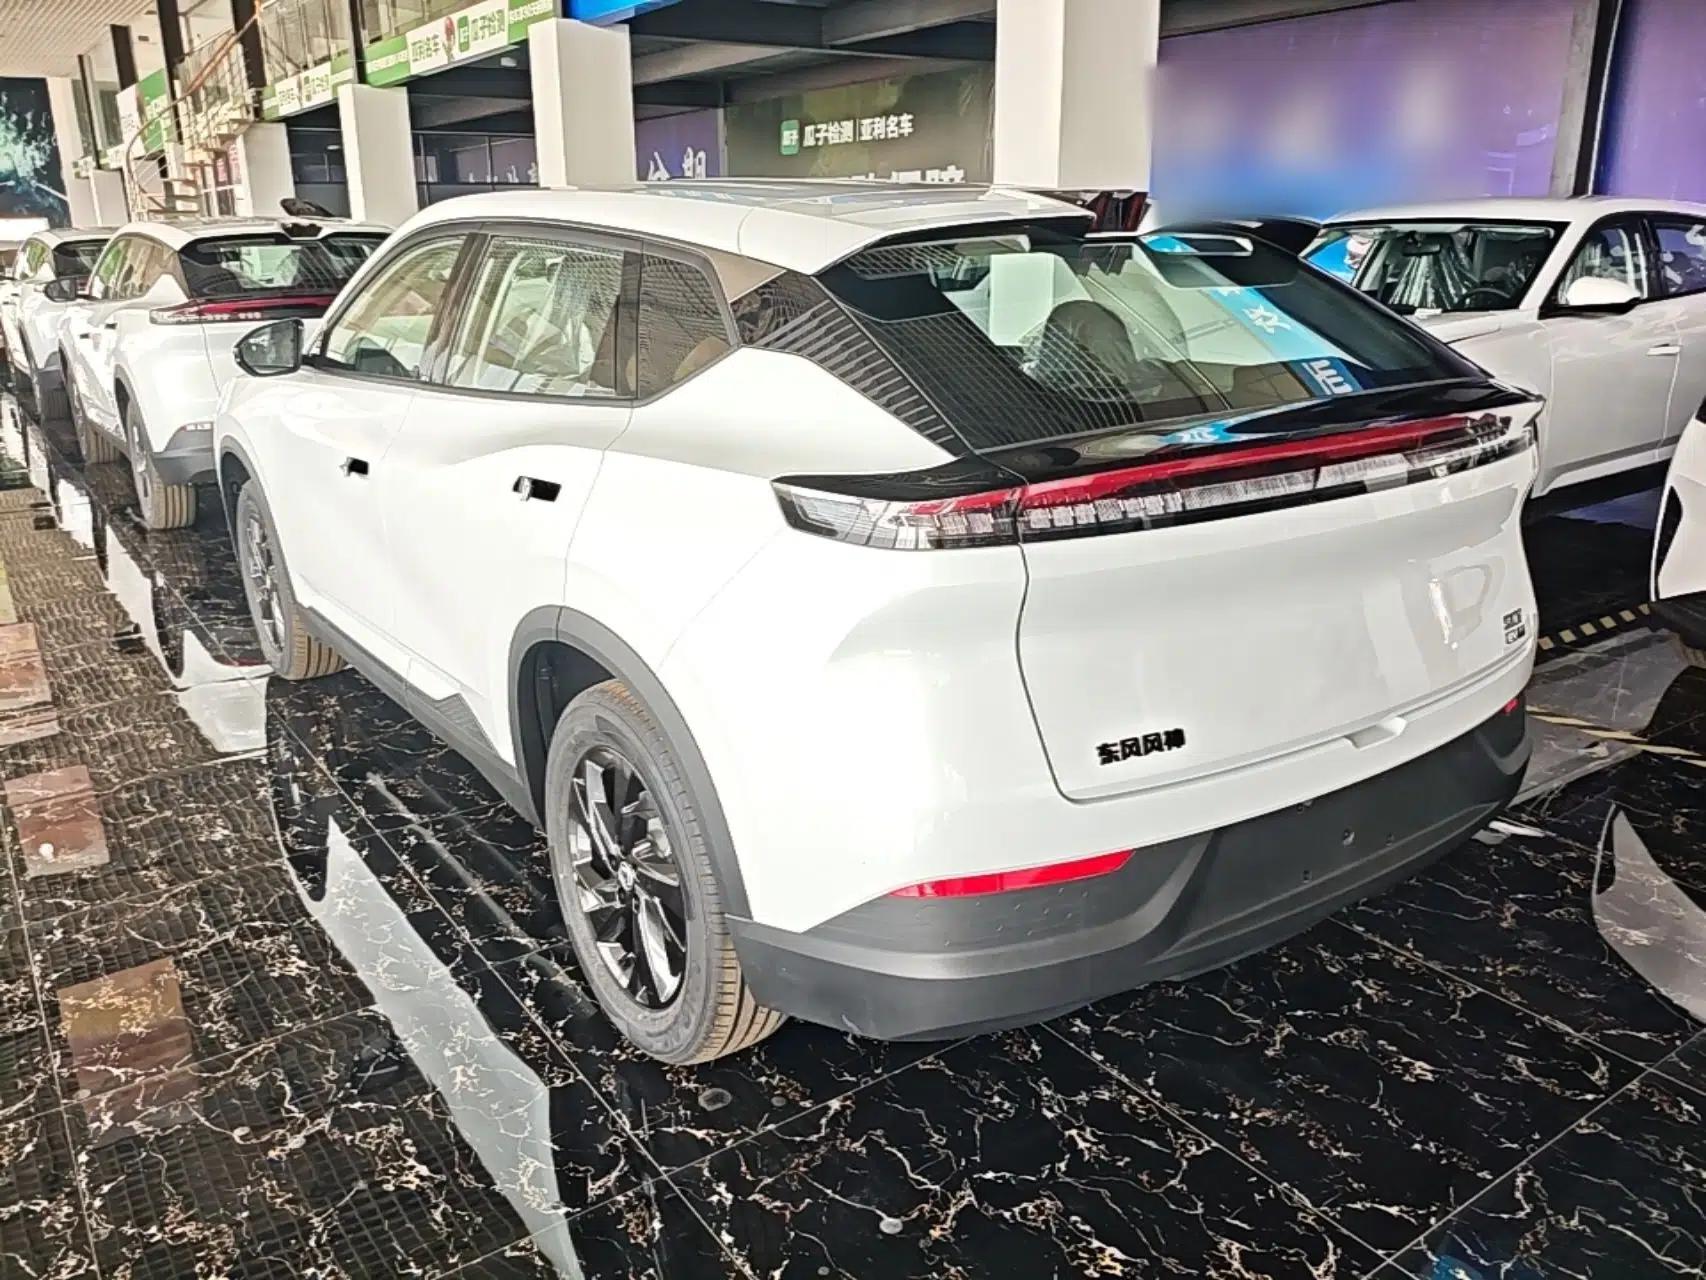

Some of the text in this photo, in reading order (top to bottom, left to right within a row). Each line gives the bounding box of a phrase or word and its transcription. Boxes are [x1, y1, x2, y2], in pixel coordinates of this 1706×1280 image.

[802, 119, 854, 147] 瓜子检测
[859, 112, 914, 141] 亚利名车
[1096, 728, 1186, 766] 东风风神
